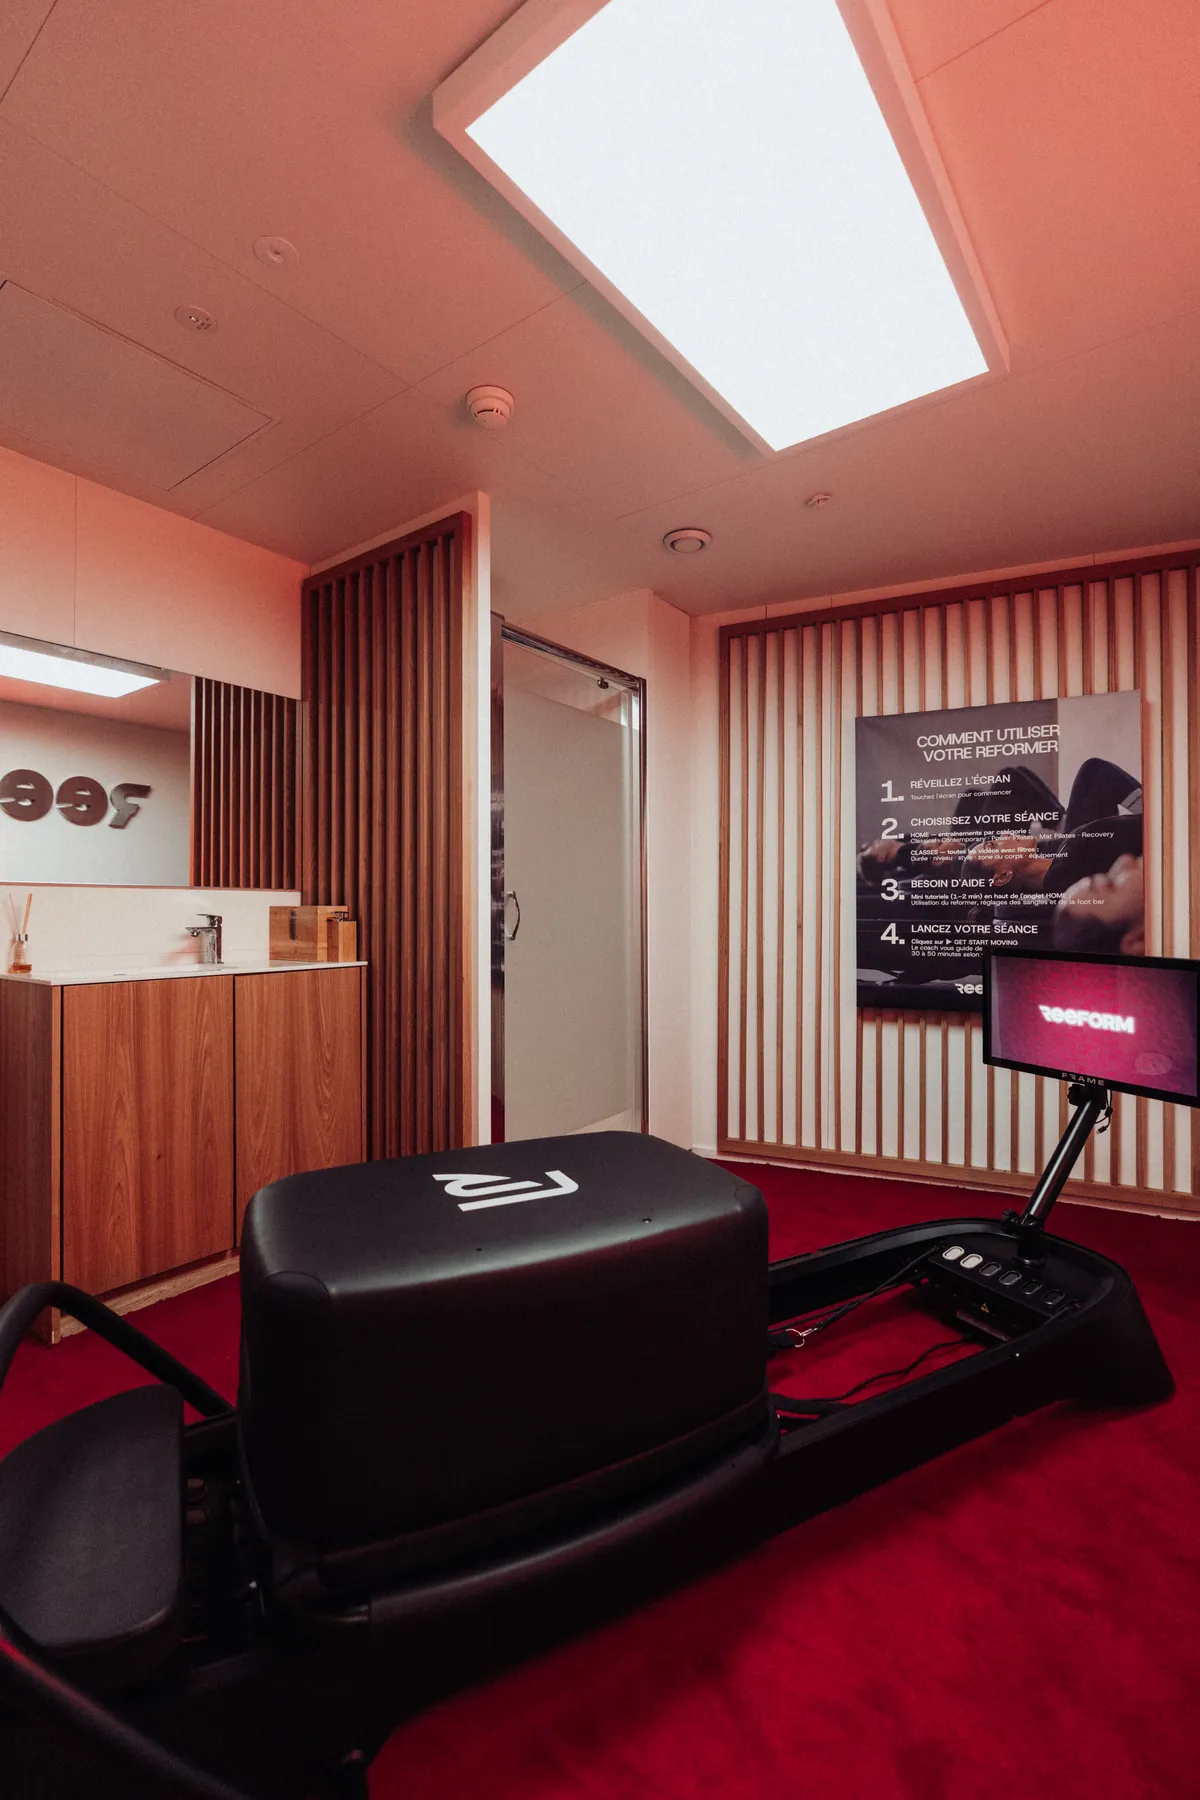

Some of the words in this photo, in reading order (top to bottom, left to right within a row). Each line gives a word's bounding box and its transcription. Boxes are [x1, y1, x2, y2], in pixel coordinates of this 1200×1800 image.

[916, 730, 994, 748] COMMENT
[997, 724, 1061, 741] UTILISER
[923, 747, 972, 762] VOTRE
[975, 740, 1059, 759] REFORMER
[880, 780, 905, 802] 1.
[910, 777, 962, 789] RÉVEILLEZ
[965, 774, 1011, 785] L'ÉCRAN
[973, 789, 1012, 797] commencer
[881, 818, 905, 839] 2.
[910, 816, 971, 826] CHOISISSEZ
[973, 814, 1011, 824] VOTRE
[1014, 810, 1059, 822] SÉANCE
[958, 854, 973, 862] style
[1028, 852, 1068, 860] équipement
[880, 878, 905, 900] 3.
[911, 879, 948, 888] BESOIN
[951, 879, 985, 887] D'AIDE
[980, 899, 1007, 907] réglages
[880, 923, 905, 945] 4.
[911, 924, 951, 933] LANCEZ
[954, 925, 991, 933] VOTRE
[994, 923, 1038, 934] SÉANCE
[1061, 1072, 1104, 1086] FRAME
